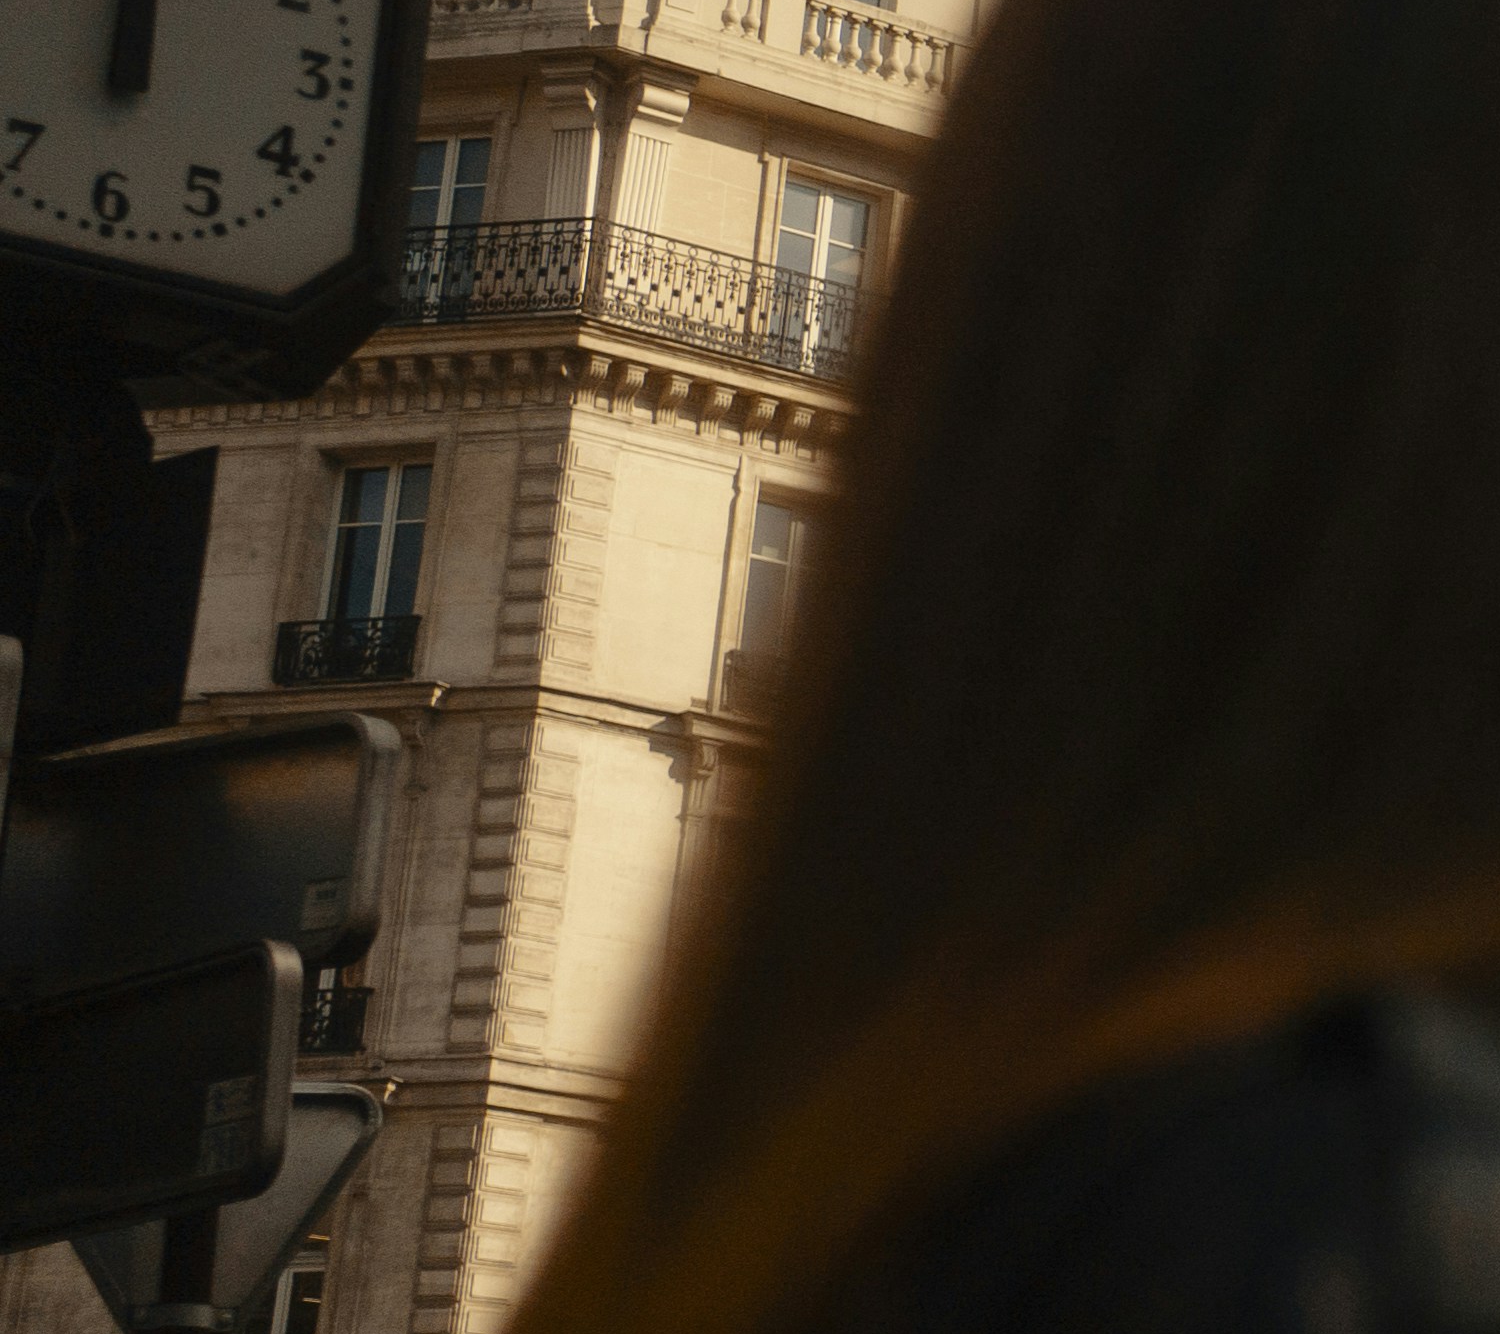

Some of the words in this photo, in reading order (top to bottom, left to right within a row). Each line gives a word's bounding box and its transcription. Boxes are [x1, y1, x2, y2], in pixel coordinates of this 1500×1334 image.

[297, 49, 331, 101] 3
[7, 118, 46, 172] 7
[256, 125, 300, 178] 4
[92, 170, 131, 222] 6
[183, 164, 222, 217] 5
